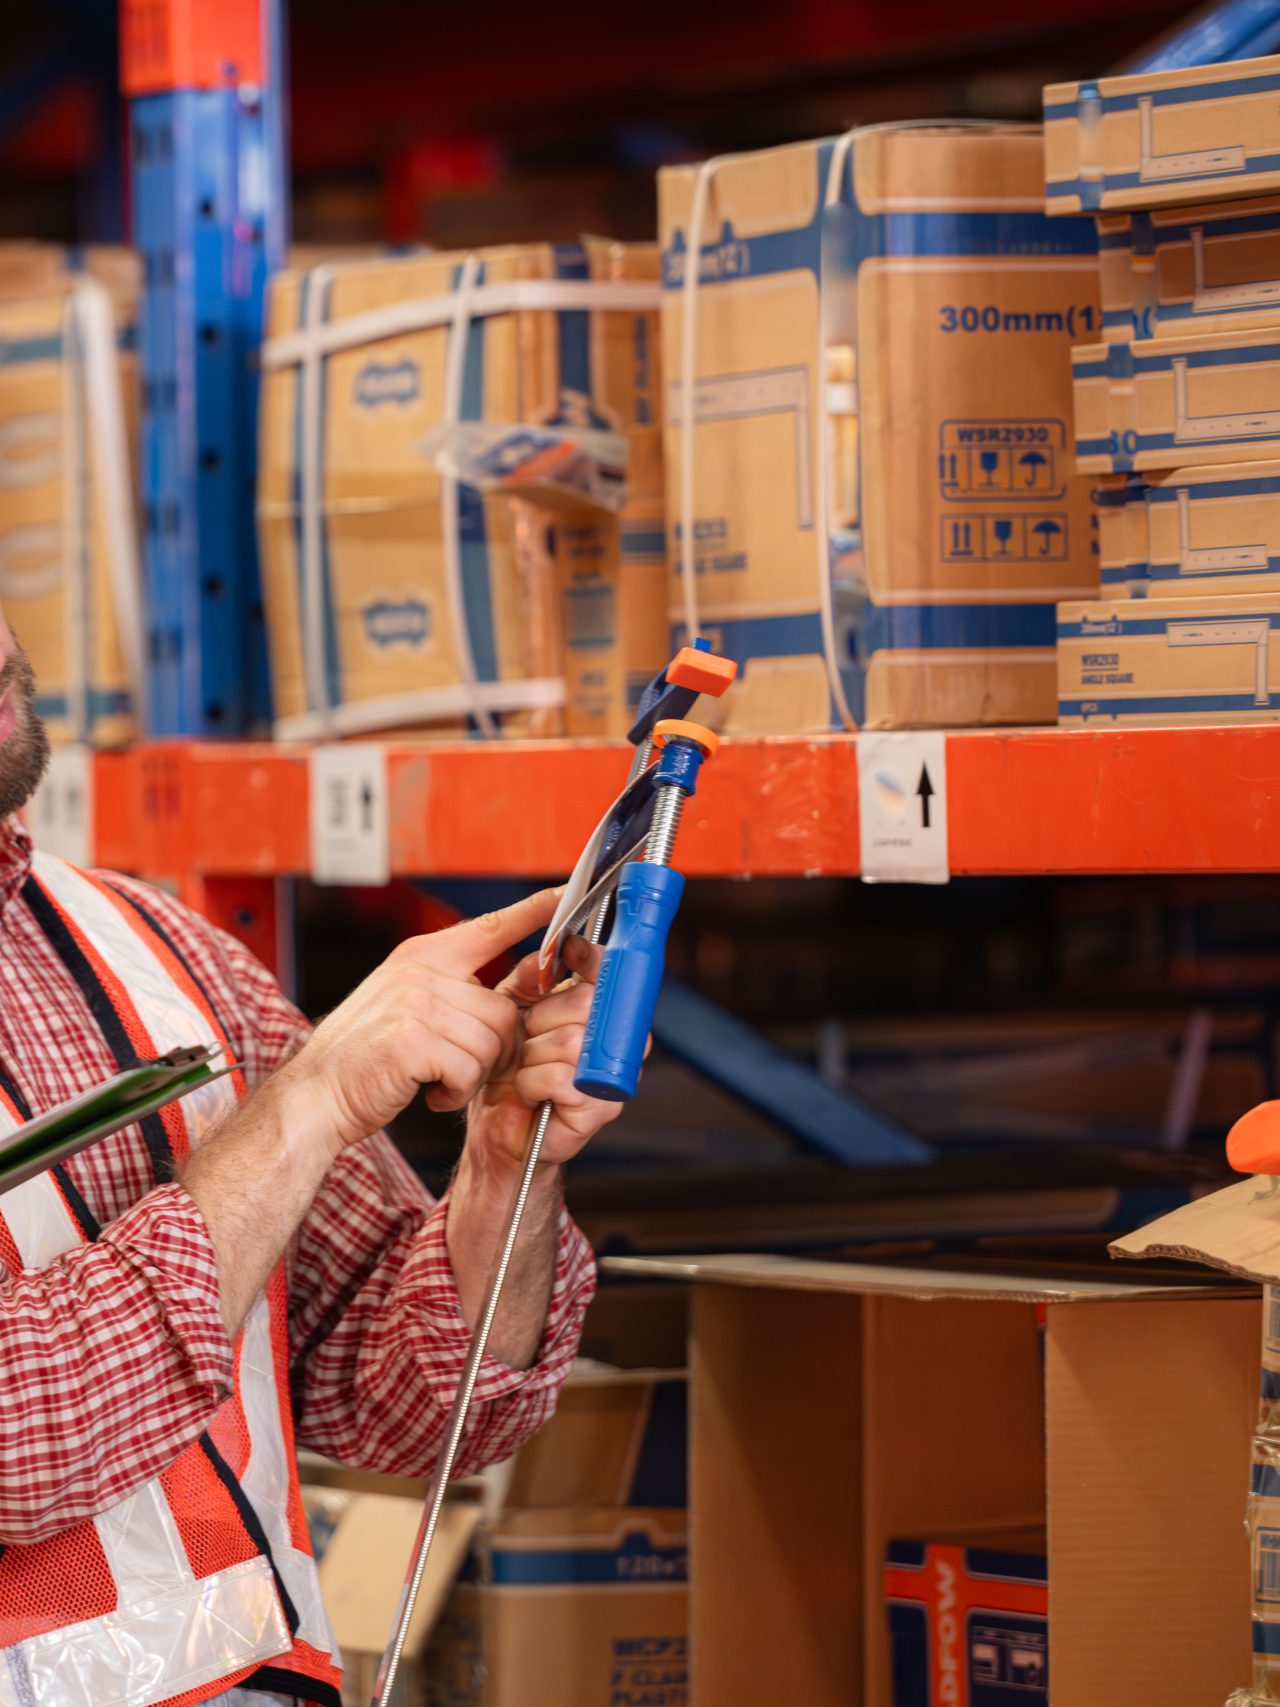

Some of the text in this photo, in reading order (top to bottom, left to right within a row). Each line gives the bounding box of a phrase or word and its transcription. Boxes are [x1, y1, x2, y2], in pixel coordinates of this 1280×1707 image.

[940, 305, 1102, 337] 300mm(1
[956, 428, 1049, 443] WSR2930
[935, 1560, 957, 1707] DFOW
